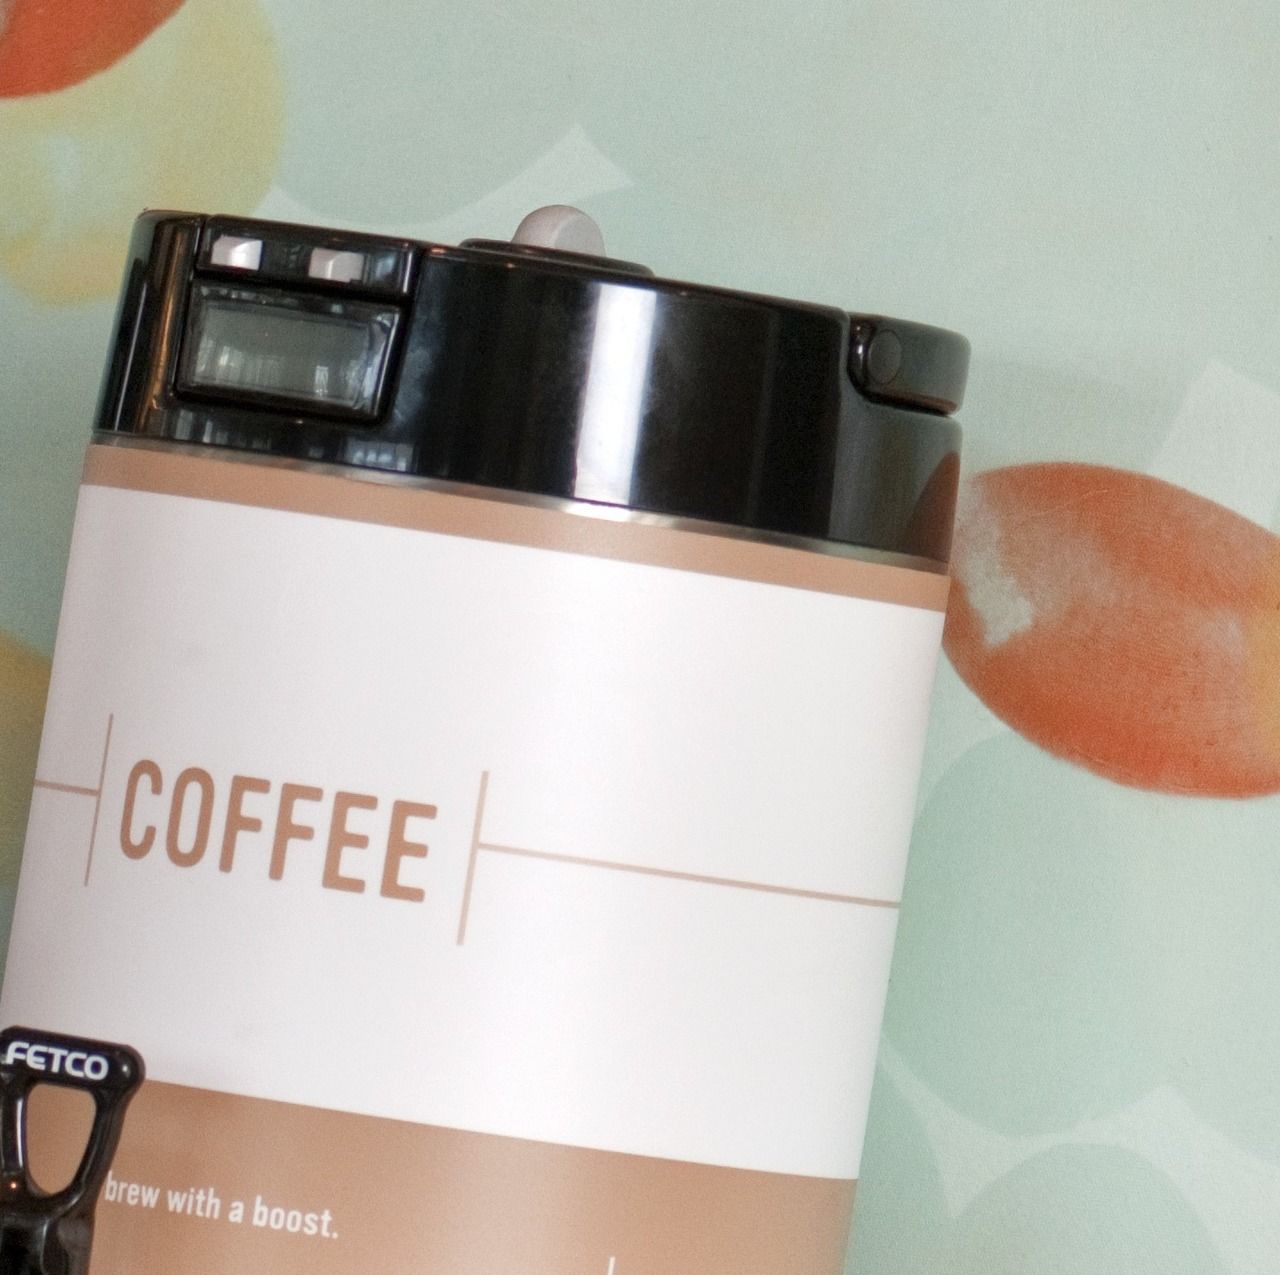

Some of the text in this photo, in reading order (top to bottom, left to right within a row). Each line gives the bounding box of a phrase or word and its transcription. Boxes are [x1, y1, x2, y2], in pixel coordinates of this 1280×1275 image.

[119, 759, 438, 902] COFFEE
[5, 1041, 109, 1080] FETCO
[104, 1170, 339, 1239] brew with a boost.
